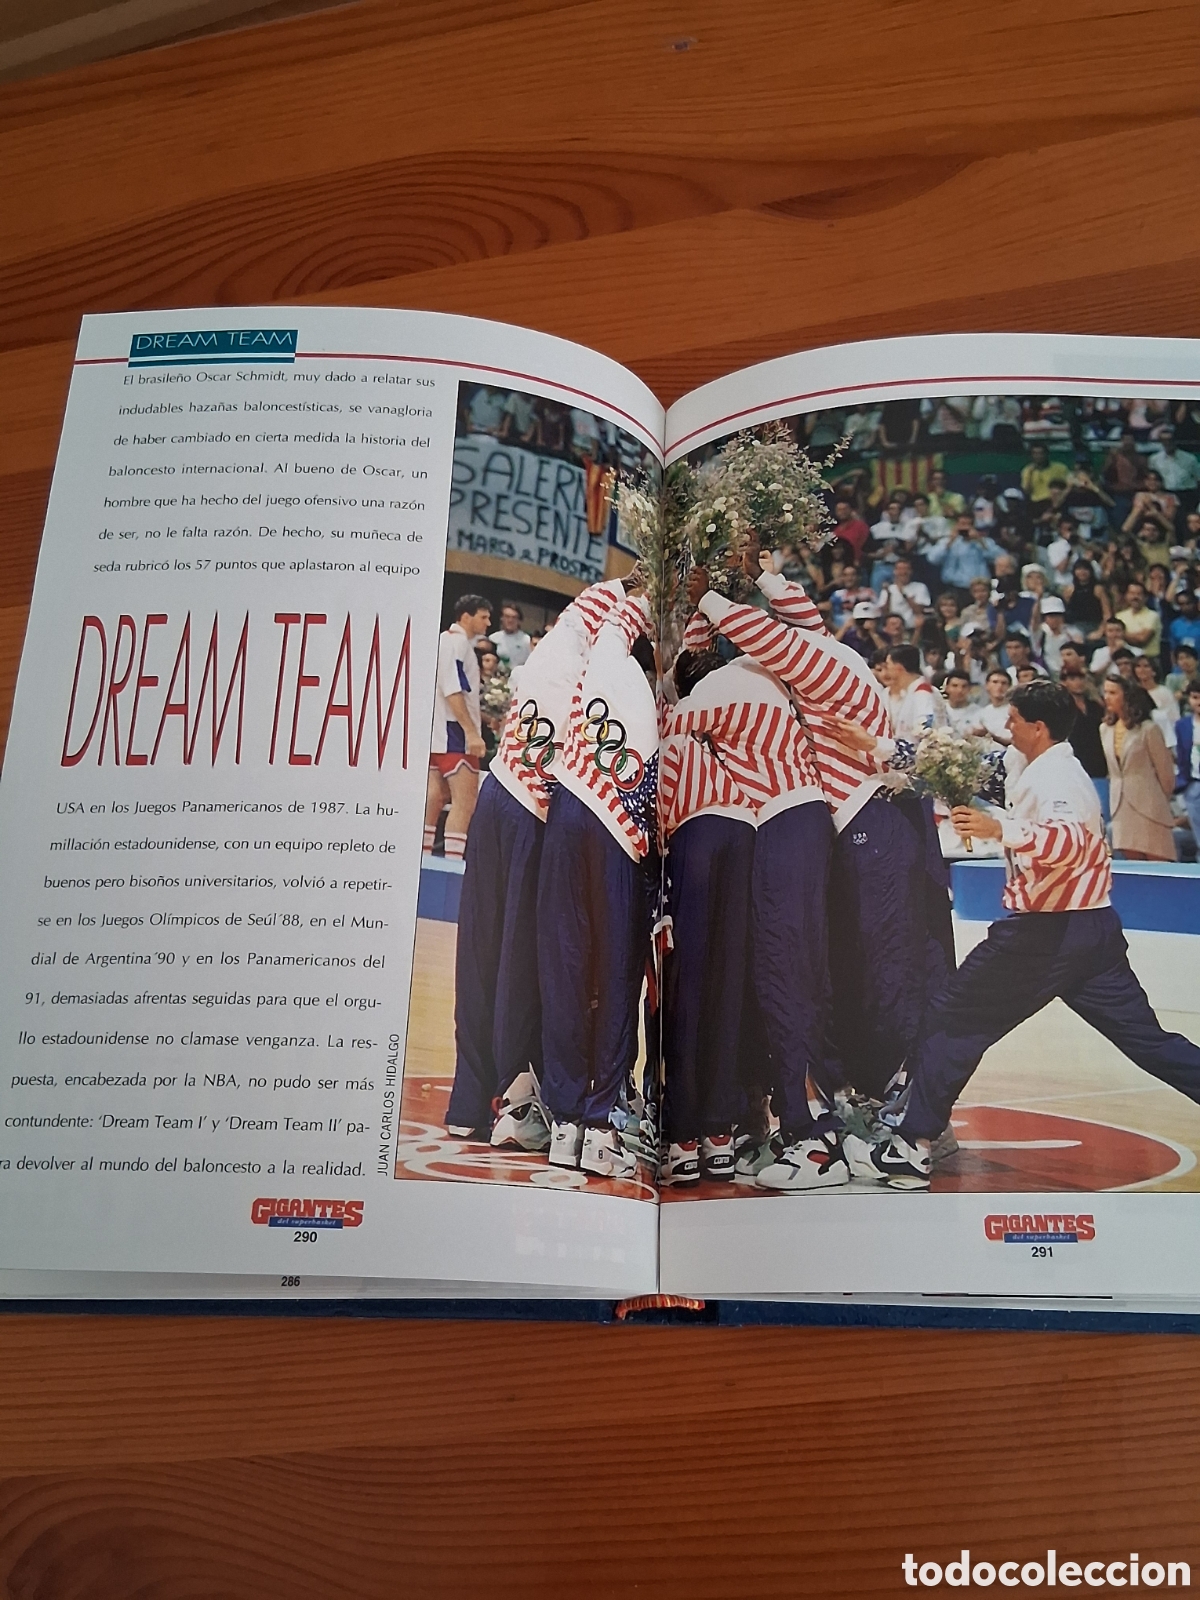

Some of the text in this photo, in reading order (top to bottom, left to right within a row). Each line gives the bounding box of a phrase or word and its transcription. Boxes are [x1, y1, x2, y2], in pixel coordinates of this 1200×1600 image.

[136, 331, 293, 350] DREAM TEAM
[123, 370, 436, 388] El brasileño Oscar Schmidt, muy dado relatar sus
[118, 400, 433, 418] indudables hazañas baloncestísticas, se vanagloria
[113, 431, 431, 448] de haber cambiado en cierta medida la historia del
[108, 461, 428, 480] baloncesto internacional. Al bueno de Oscar, un
[103, 493, 425, 511] hombre que ha hecho del juego ofensivo una razón
[98, 525, 424, 543] de ser, no le falta razón. De hecho, su muñeca de
[93, 558, 421, 578] seda rubricó los 57 puntos que aplastaron al equipo
[60, 609, 412, 772] DREAM TEAM
[56, 800, 371, 816] USA en los Juegos Panamericanos de 1987. La
[49, 836, 396, 855] millación estadounidense, con un equipo repleto de
[43, 874, 393, 893] buenos pero bisoños universitarios, volvió repetir-
[37, 911, 389, 930] se en los Juegos Olímpicos de en el Mun-
[30, 950, 386, 969] dial de en los Panamericanos del
[25, 990, 382, 1010] 91, demasiadas afrentas seguidas para que el orgu-
[18, 1030, 379, 1050] llo estadounidense no clamase venganza. La res-
[10, 1071, 375, 1091] puesta, encabezada por la NBA, no pudo ser más
[377, 1033, 400, 1177] JUAN CARLOS HIDALGO
[4, 1113, 324, 1132] contundente: Team Team
[16, 1154, 366, 1177] devolver al mundo del baloncesto la realidad.
[251, 1197, 365, 1228] GIGANTES
[293, 1231, 318, 1243] 290
[984, 1214, 1096, 1241] GIGANTES
[1031, 1246, 1054, 1258] 291
[281, 1275, 301, 1287] 286
